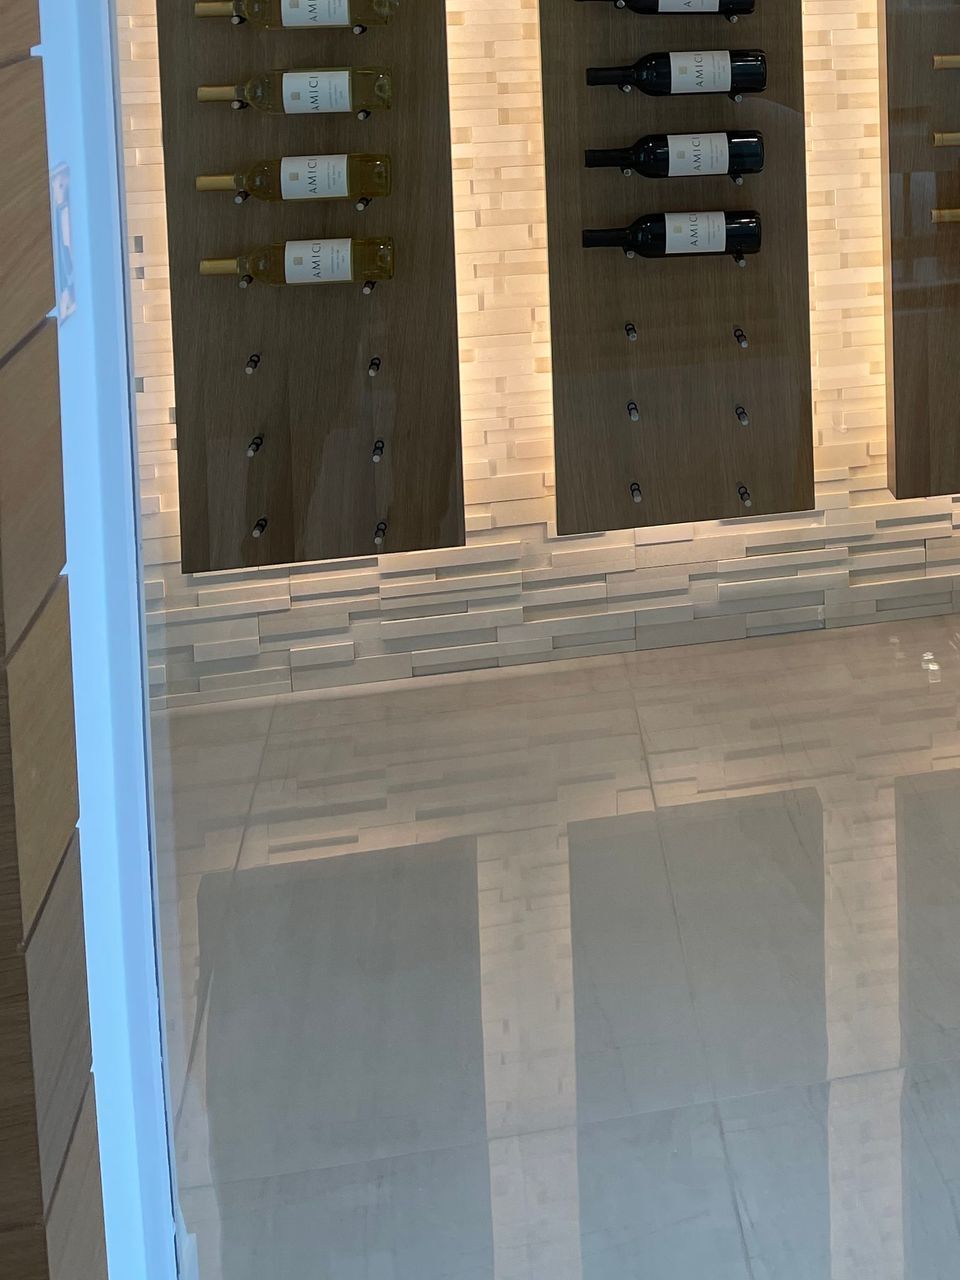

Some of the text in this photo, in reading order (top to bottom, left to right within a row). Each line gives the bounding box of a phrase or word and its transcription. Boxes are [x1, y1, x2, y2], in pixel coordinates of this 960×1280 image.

[694, 53, 704, 87] AMICI
[309, 76, 320, 111] AMICI
[692, 136, 702, 171] AMICI
[308, 158, 318, 194] AMICI
[689, 213, 698, 247] AMICI
[312, 242, 322, 278] AMICI
